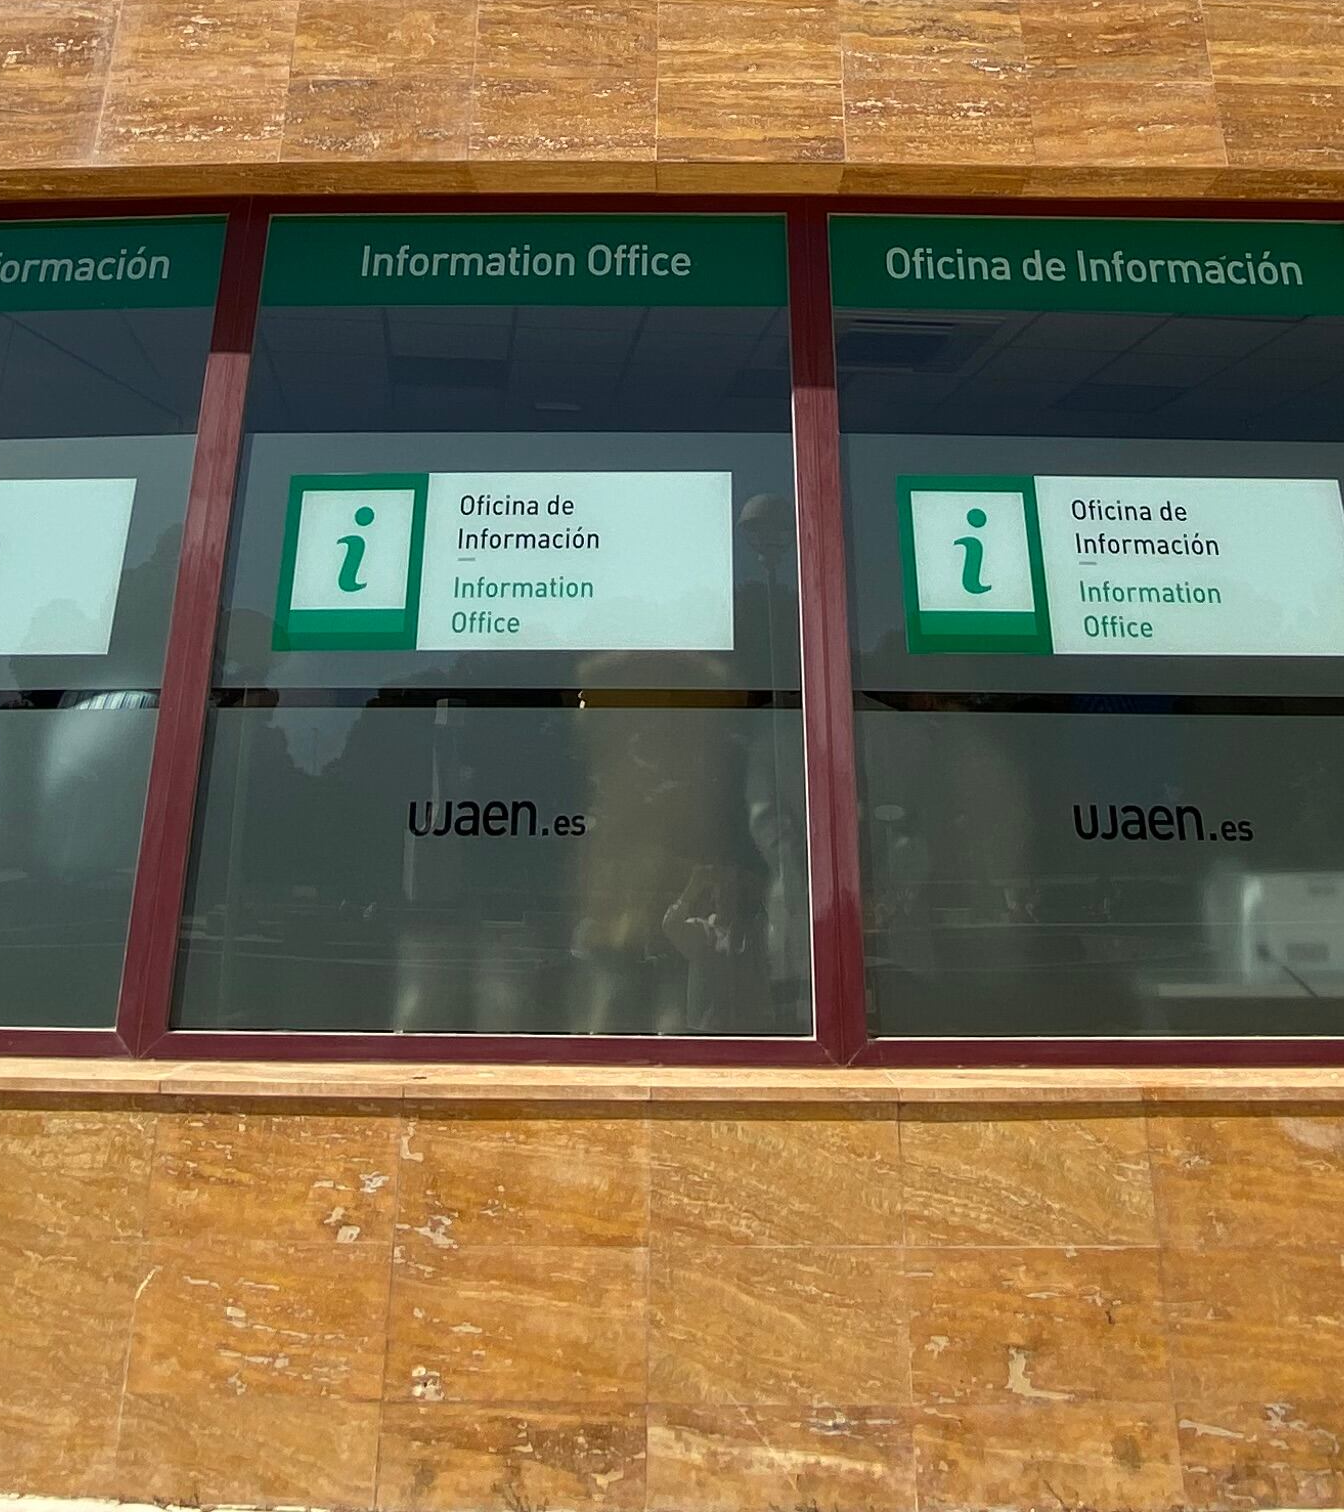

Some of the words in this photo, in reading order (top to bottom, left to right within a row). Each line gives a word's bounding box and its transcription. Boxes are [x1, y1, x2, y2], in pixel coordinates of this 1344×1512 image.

[361, 245, 576, 277] Information
[588, 244, 692, 277] Office
[885, 247, 1011, 280] Oficina
[1023, 250, 1066, 281] de
[1077, 250, 1304, 285] Información
[460, 495, 539, 516] Oficina
[547, 495, 574, 516] de
[1071, 499, 1152, 521] Oficina
[1159, 501, 1187, 522] de
[457, 527, 600, 550] Información
[1075, 533, 1220, 556] Información
[454, 576, 594, 599] Information
[1079, 580, 1222, 604] Information
[451, 611, 520, 634] Office
[1084, 615, 1153, 638] Office
